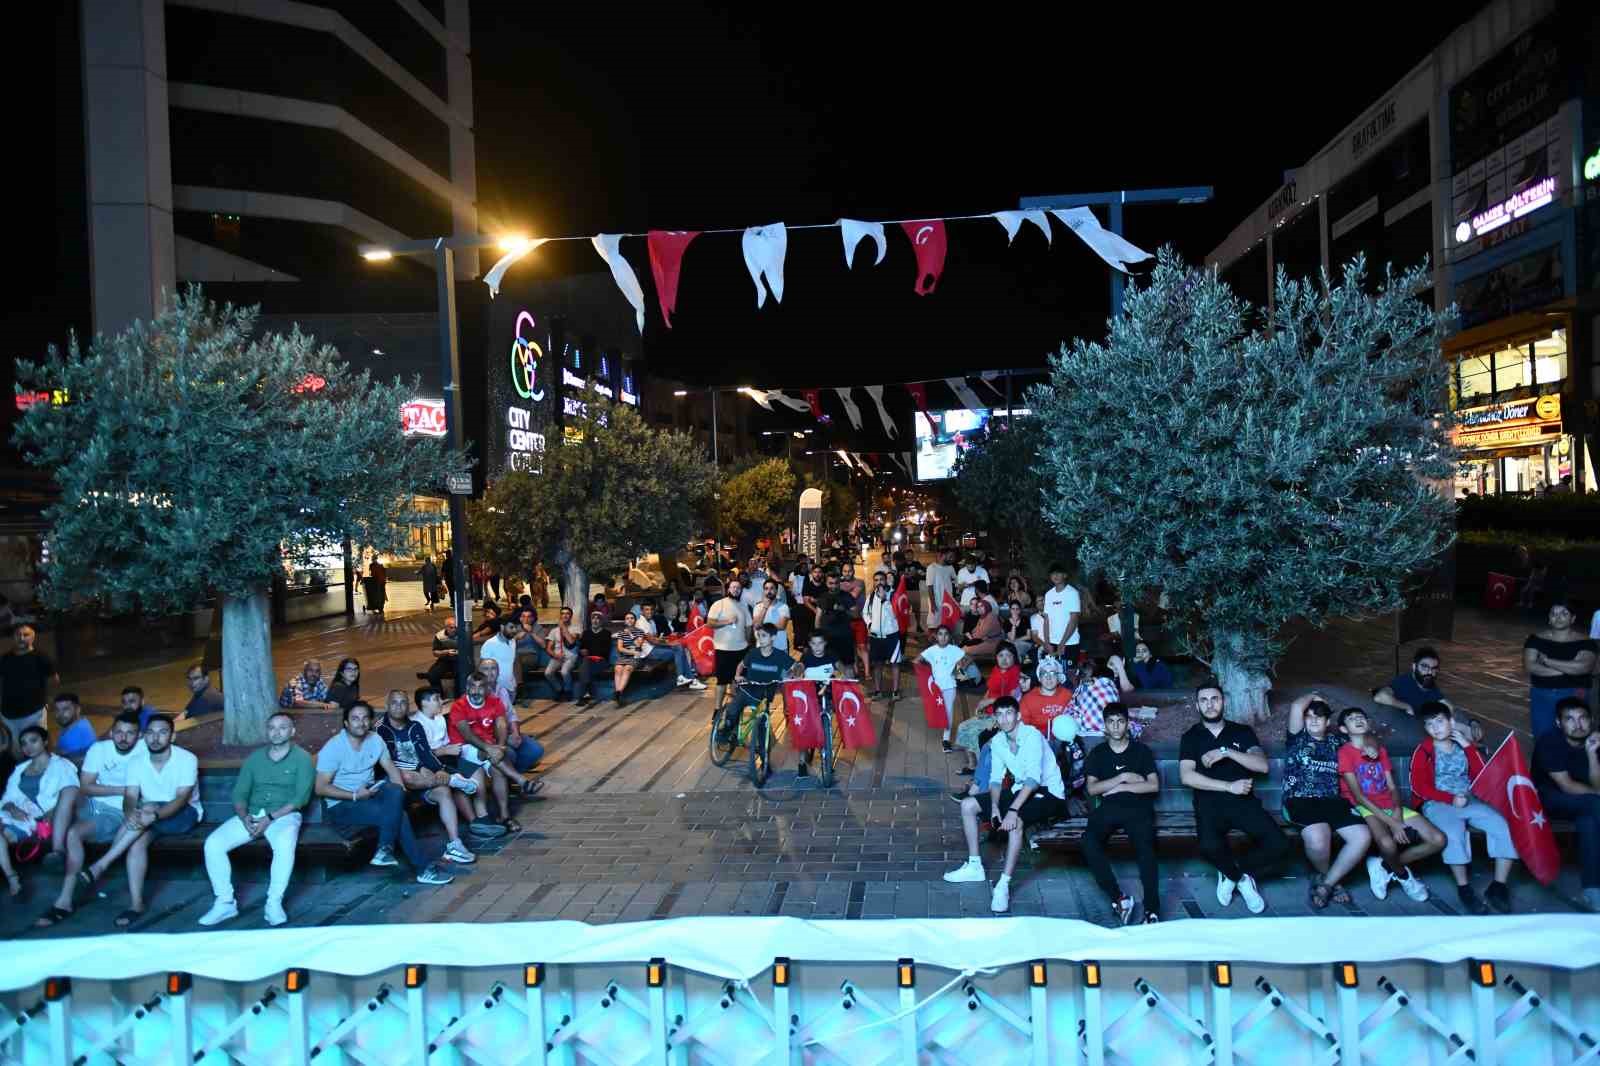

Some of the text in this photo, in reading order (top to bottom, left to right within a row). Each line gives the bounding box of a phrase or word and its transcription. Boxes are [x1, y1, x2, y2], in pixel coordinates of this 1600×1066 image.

[408, 407, 445, 432] TAÇ
[509, 406, 530, 430] CITY
[1503, 403, 1529, 419] Döner
[510, 429, 546, 452] CENTER
